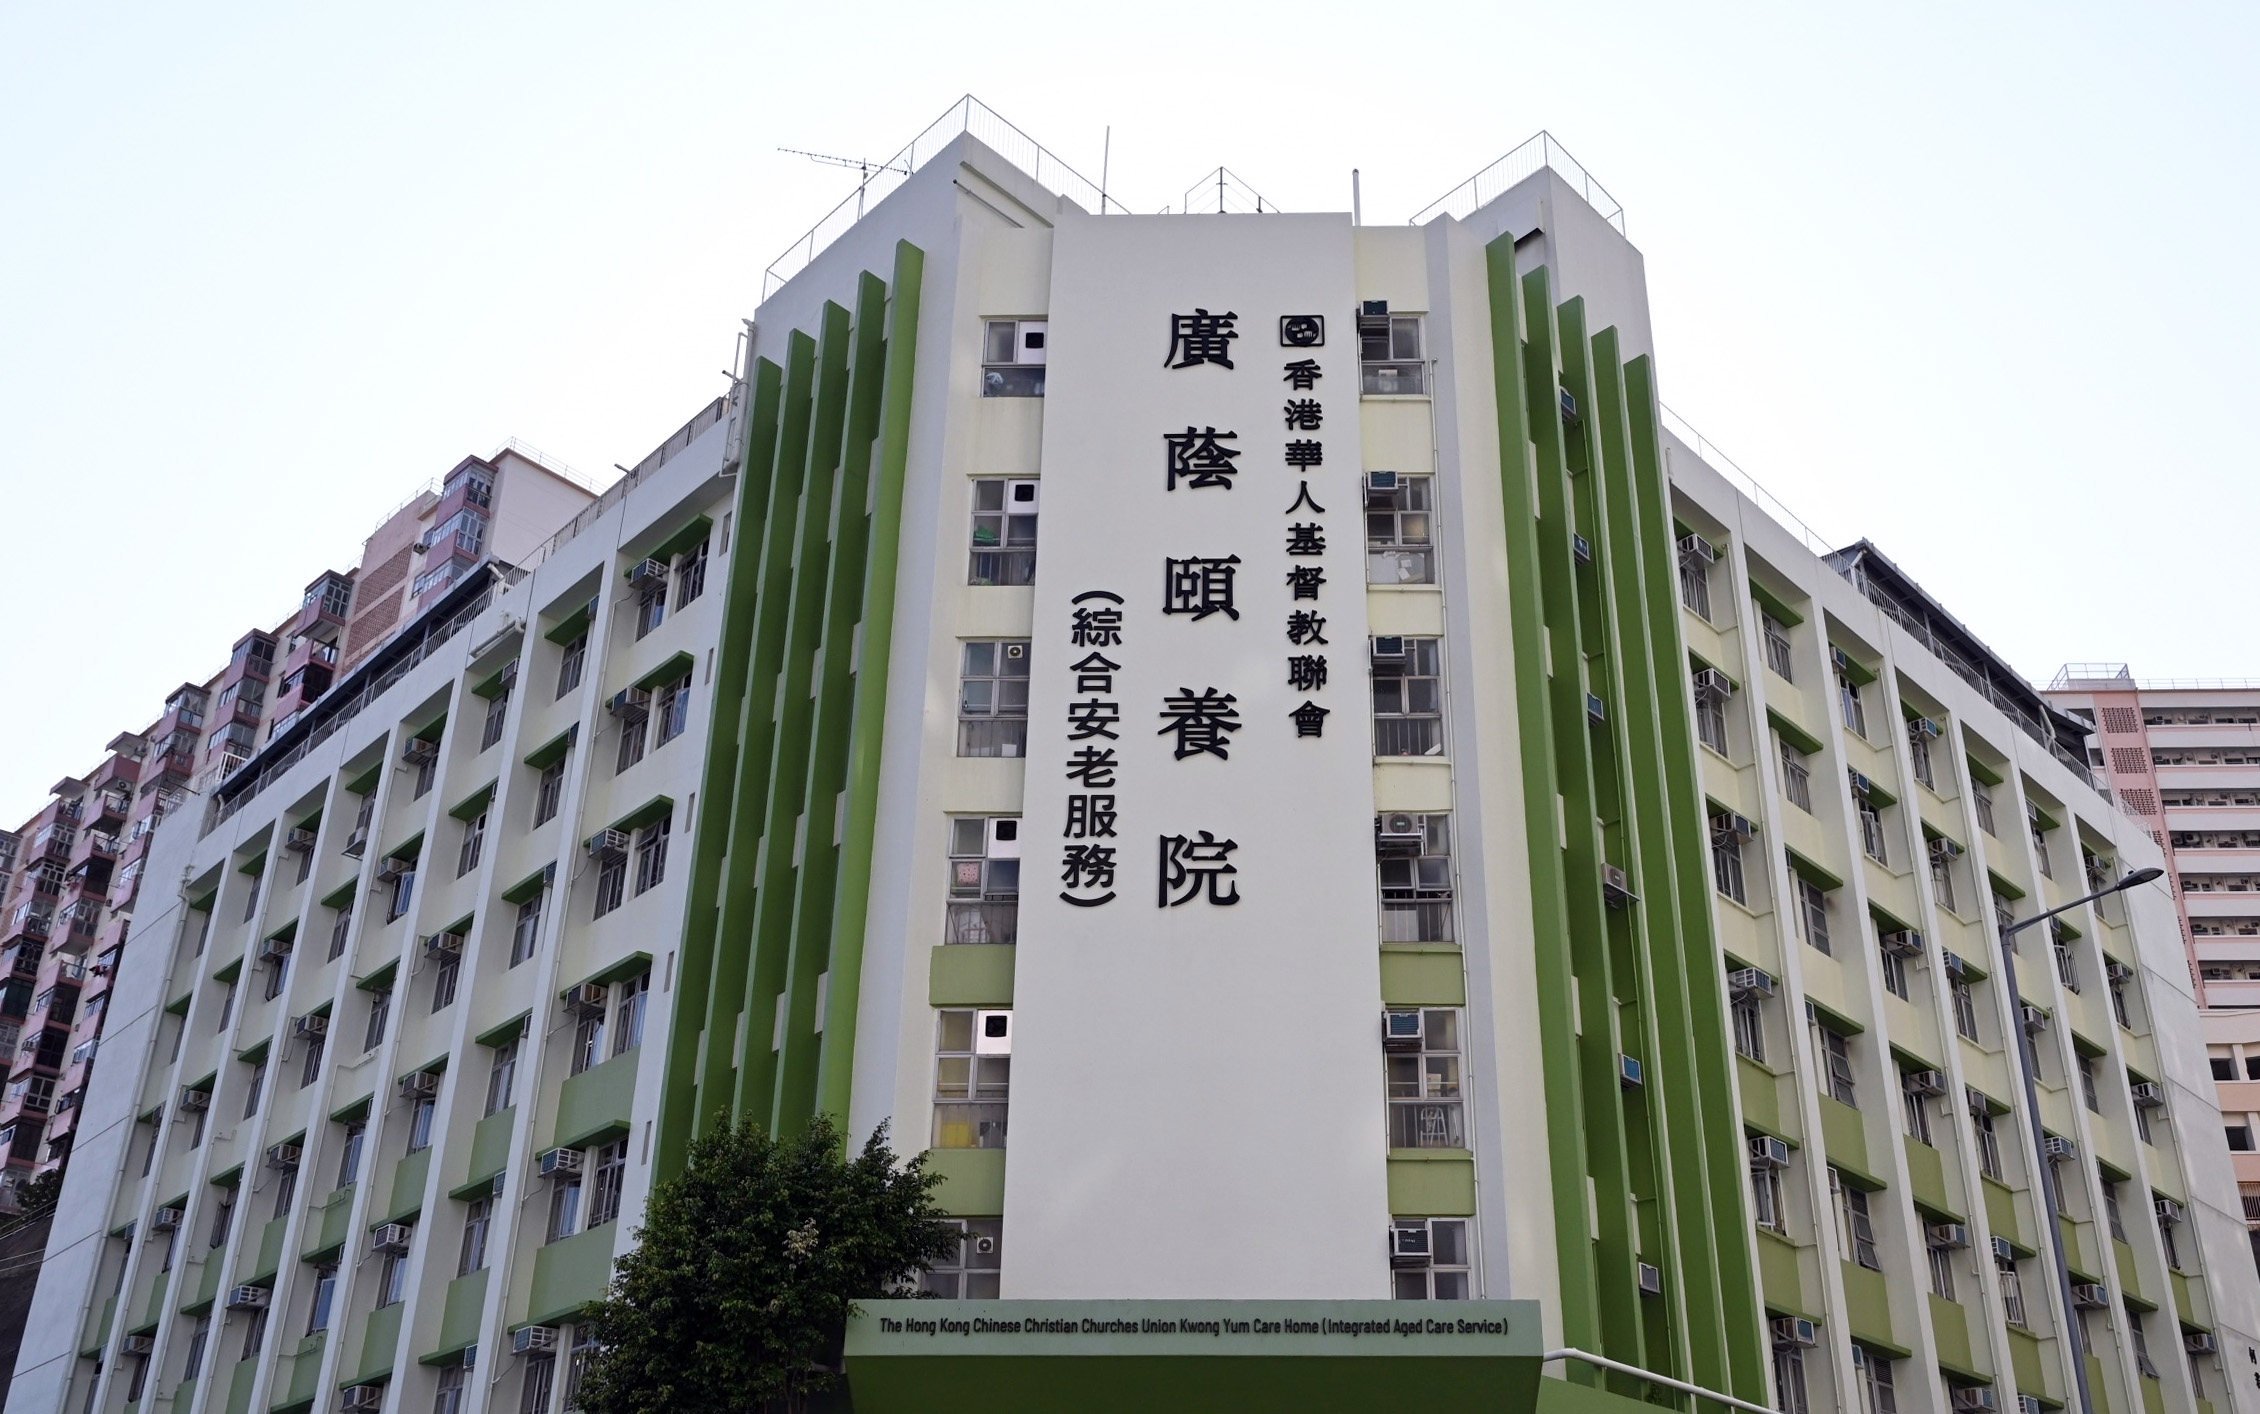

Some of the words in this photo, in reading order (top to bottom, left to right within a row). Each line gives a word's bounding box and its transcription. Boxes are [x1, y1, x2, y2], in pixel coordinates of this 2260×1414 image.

[1157, 307, 1243, 909] 廣蔭頤養院
[1282, 358, 1331, 739] 香港華人基督教聯會
[879, 1318, 903, 1333] The
[905, 1318, 937, 1336] Hong
[939, 1318, 971, 1336] Kong
[972, 1318, 1022, 1333] Chinese
[1024, 1318, 1079, 1333] Christian
[1081, 1318, 1139, 1333] Churches
[1141, 1318, 1177, 1333] Union
[1179, 1318, 1220, 1336] Kwong
[1222, 1318, 1251, 1333] Yum
[1253, 1318, 1282, 1333] Care
[1284, 1318, 1320, 1333] Home
[1322, 1318, 1391, 1336] (Integrated
[1392, 1318, 1424, 1336] Aged
[1425, 1318, 1455, 1333] Care
[1457, 1318, 1509, 1336] Service)
